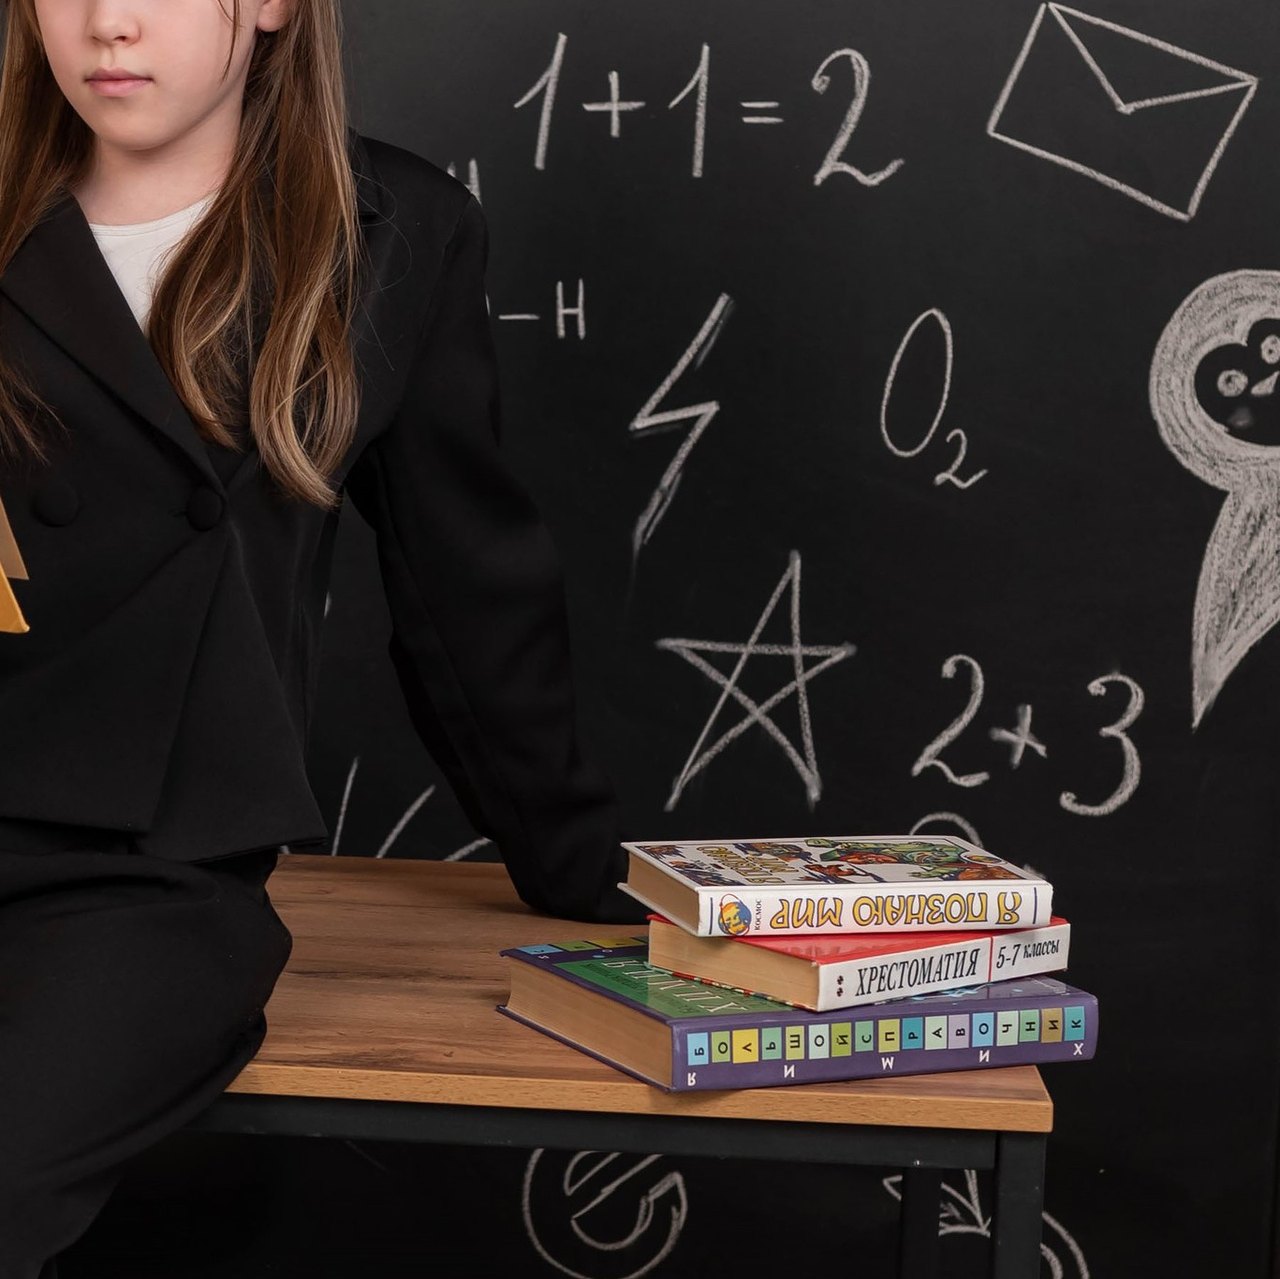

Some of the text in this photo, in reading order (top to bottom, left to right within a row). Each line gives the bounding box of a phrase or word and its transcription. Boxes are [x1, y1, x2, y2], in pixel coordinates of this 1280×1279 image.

[753, 898, 763, 932] КОСМОС
[769, 891, 1024, 930] Я ПОЗНАЮ МИР
[854, 937, 1061, 997] ХРЕСТОМАТИЯ 5-7 классы
